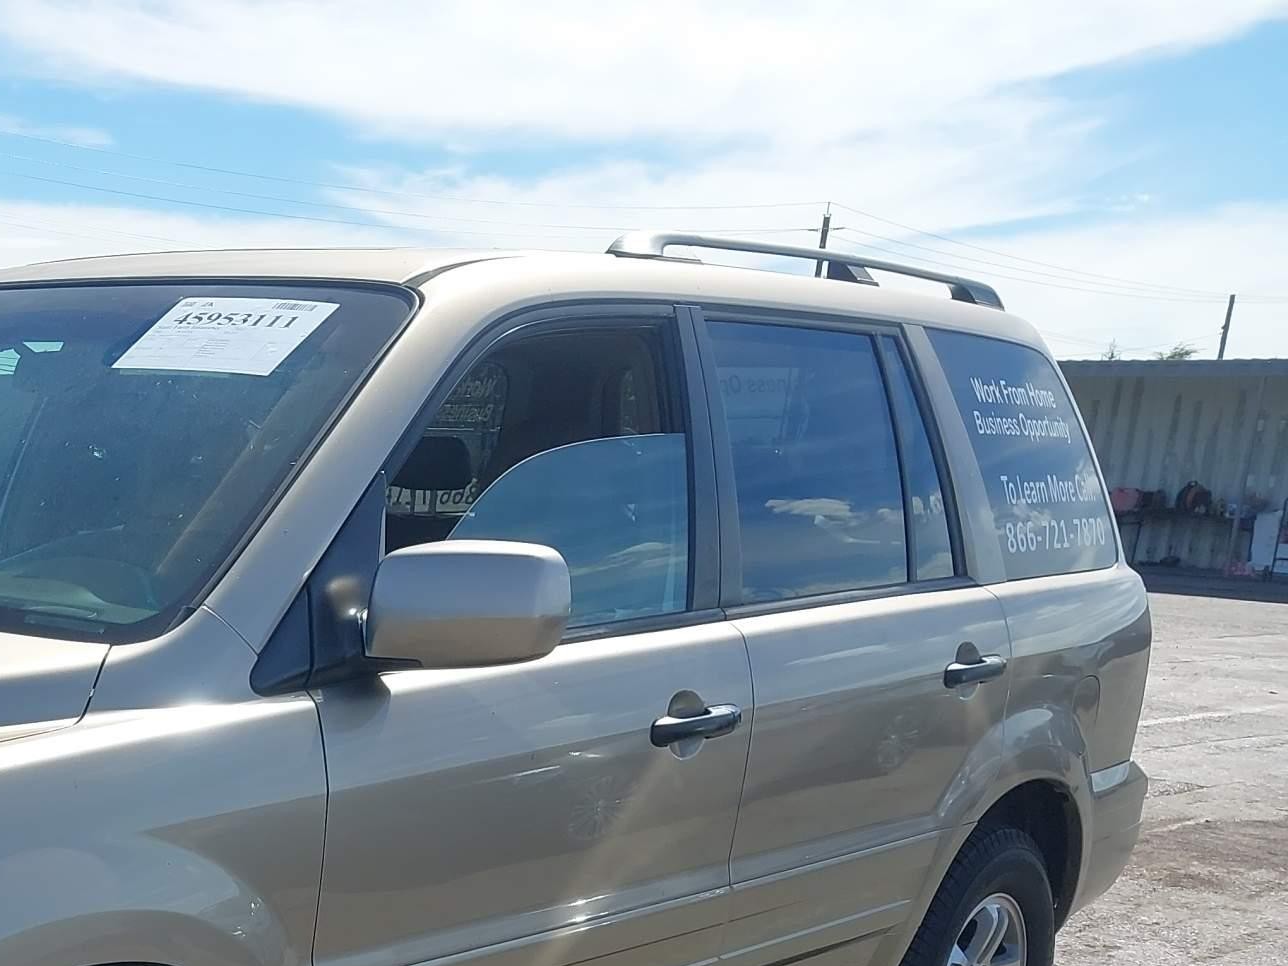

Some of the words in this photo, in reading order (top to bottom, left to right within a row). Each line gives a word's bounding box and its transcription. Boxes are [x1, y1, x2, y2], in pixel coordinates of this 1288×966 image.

[174, 311, 300, 329] 45953111
[970, 376, 1002, 404] Work
[1002, 380, 1027, 407] From
[1027, 382, 1056, 409] Home
[974, 411, 1020, 436] Business
[1020, 412, 1071, 444] Opportunity
[1000, 475, 1017, 505] To
[1016, 474, 1049, 504] Learn
[1047, 474, 1076, 503] More
[1006, 518, 1105, 553] 866-721-7870
